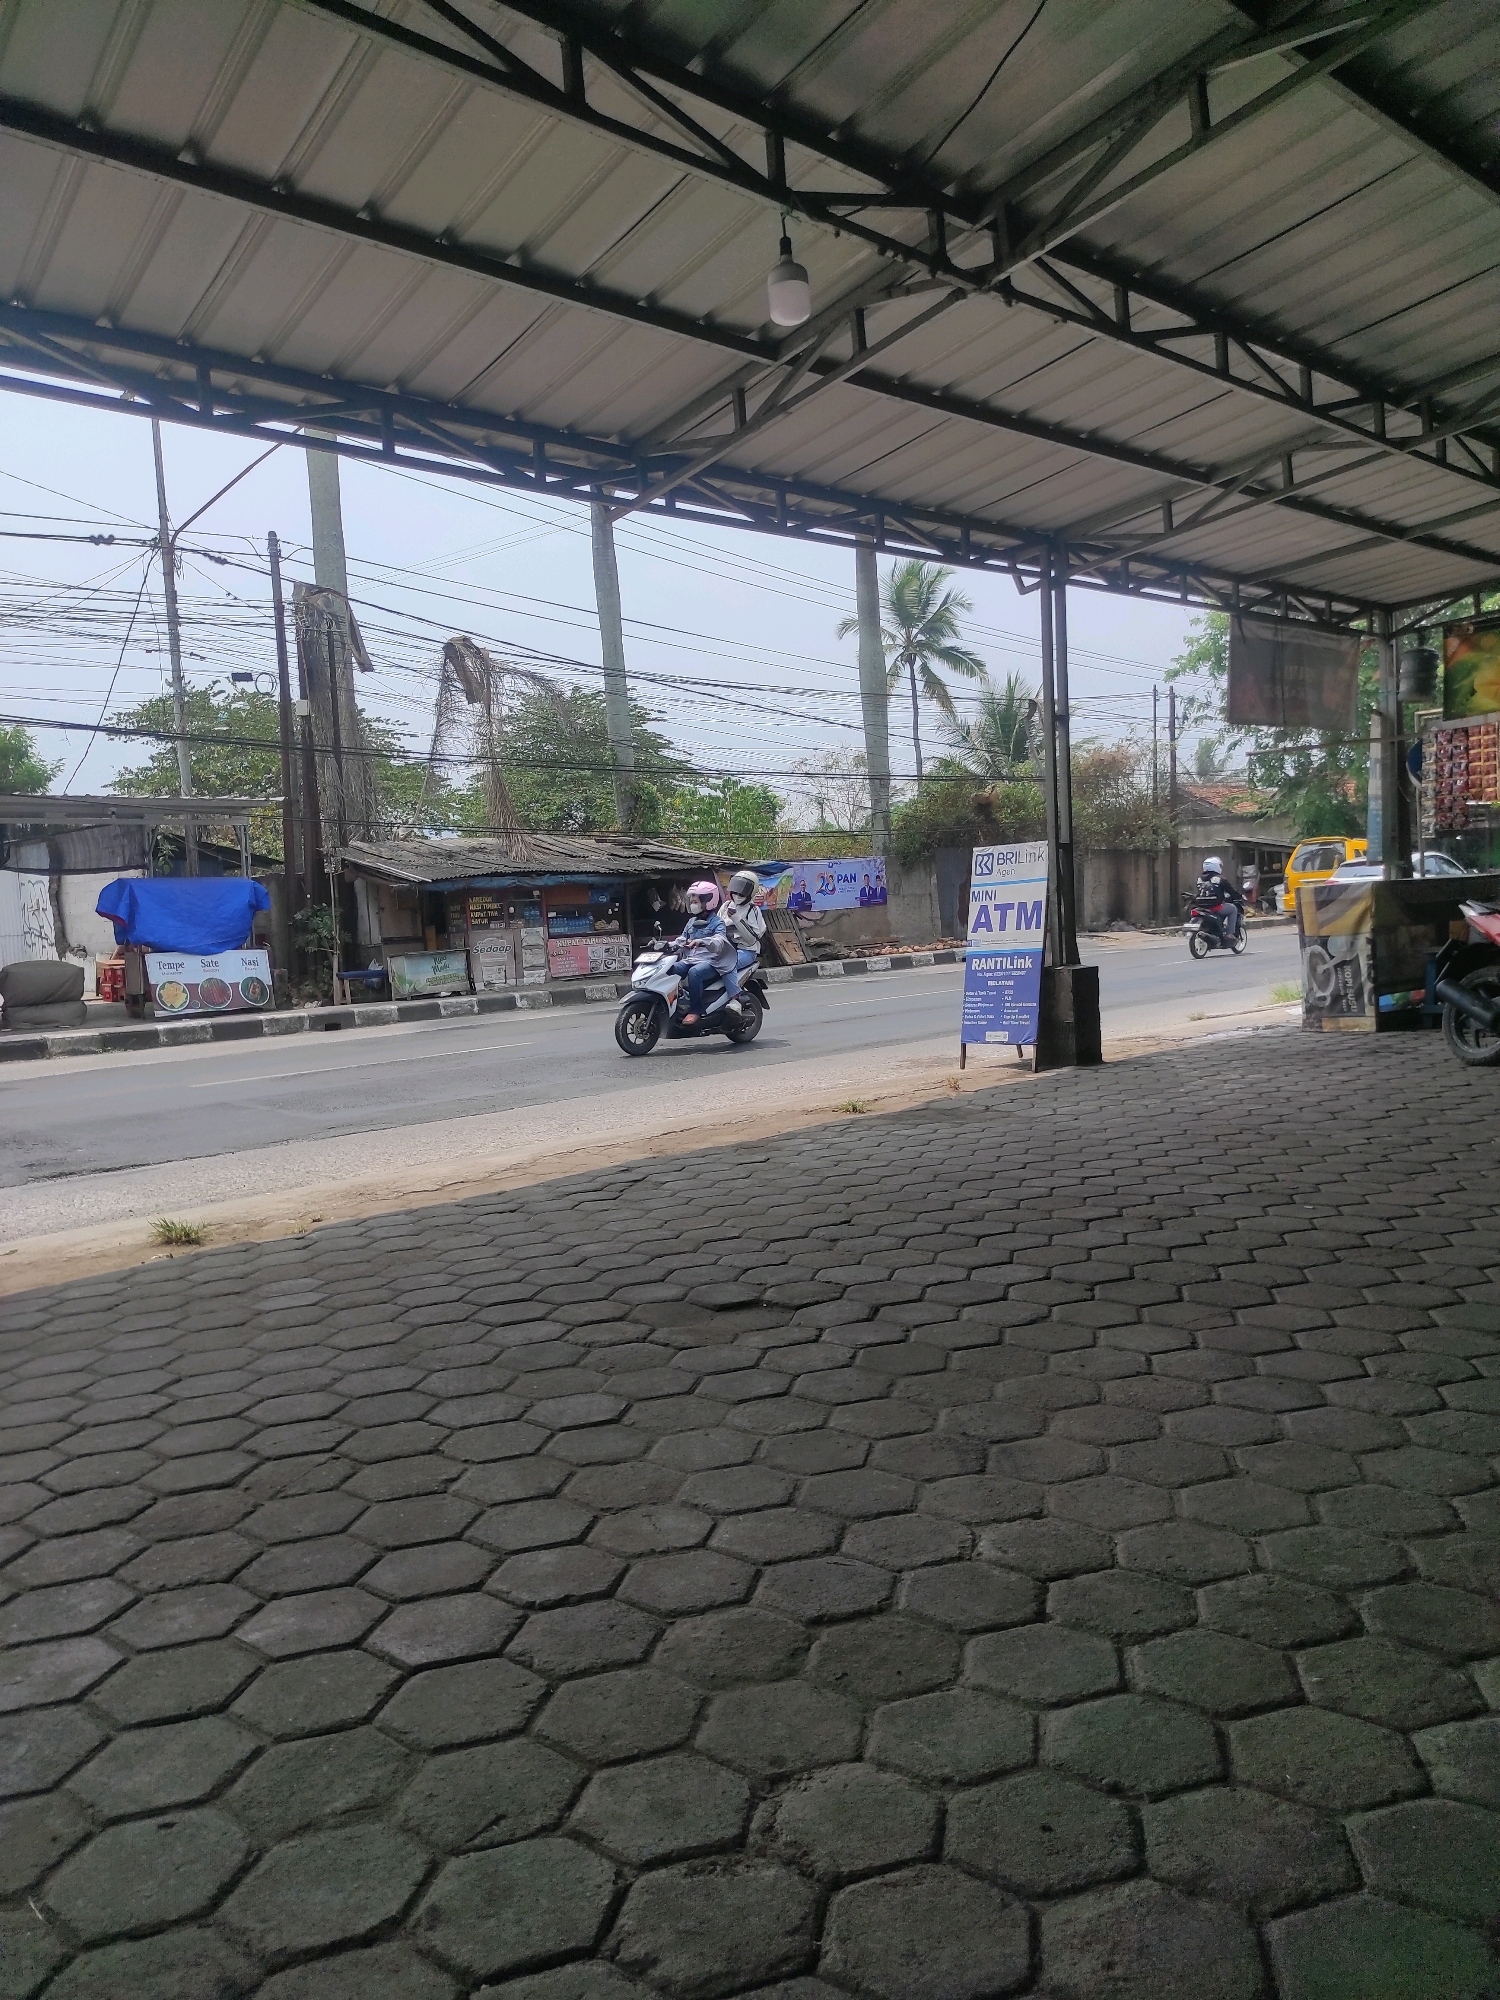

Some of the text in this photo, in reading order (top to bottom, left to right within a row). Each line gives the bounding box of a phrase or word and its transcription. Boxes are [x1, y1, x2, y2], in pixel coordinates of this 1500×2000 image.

[997, 847, 1044, 866] BRILink
[837, 873, 857, 884] PAN
[996, 868, 1016, 878] Agen
[971, 890, 997, 903] MINI
[970, 900, 1043, 933] ATM
[472, 944, 512, 955] Sedaap
[156, 957, 259, 972] Tempe Sate Nasi
[971, 956, 1033, 970] RANTILink
[1344, 965, 1358, 1012] KOPI SUSU
